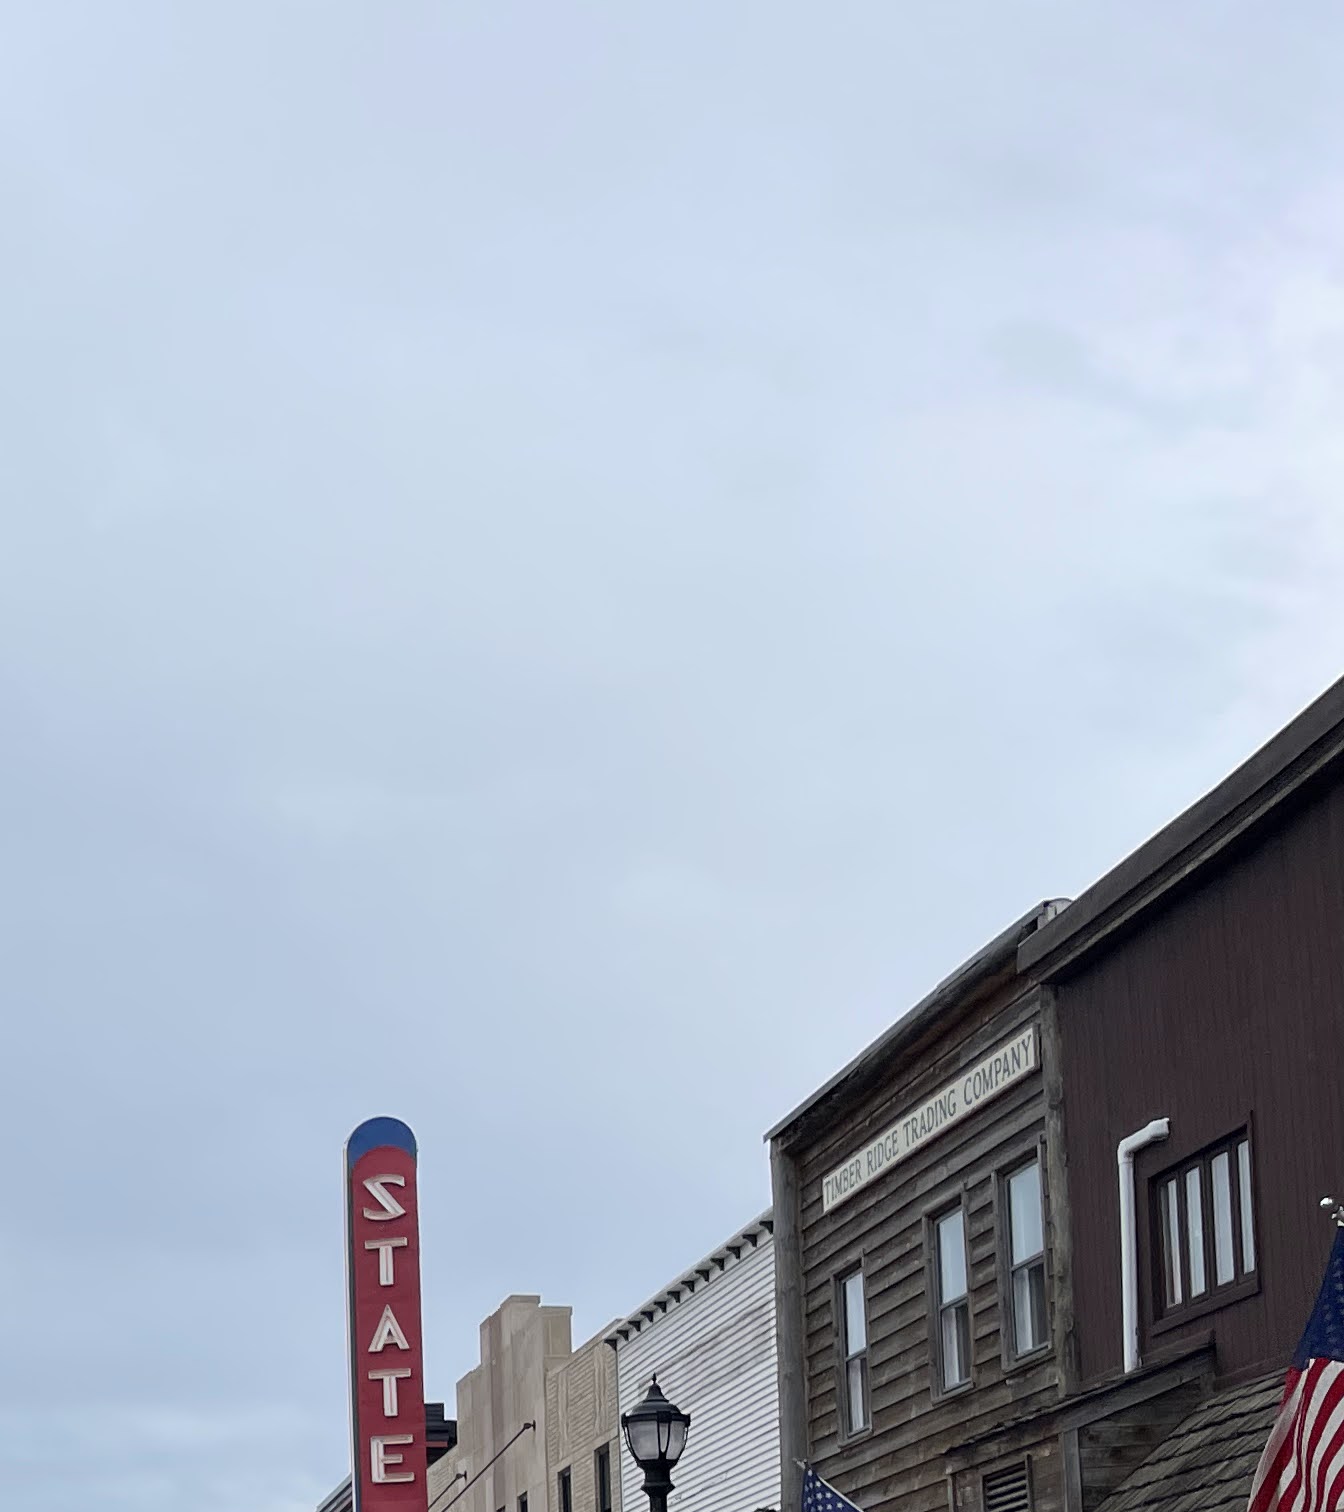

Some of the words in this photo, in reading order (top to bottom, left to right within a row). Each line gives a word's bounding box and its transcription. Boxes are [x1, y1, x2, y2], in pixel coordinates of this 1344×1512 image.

[823, 1157, 862, 1205] TIMBER
[866, 1129, 898, 1177] RIDGE
[902, 1089, 957, 1147] TRADING
[963, 1033, 1032, 1106] COMPANY
[362, 1174, 415, 1484] STATE
